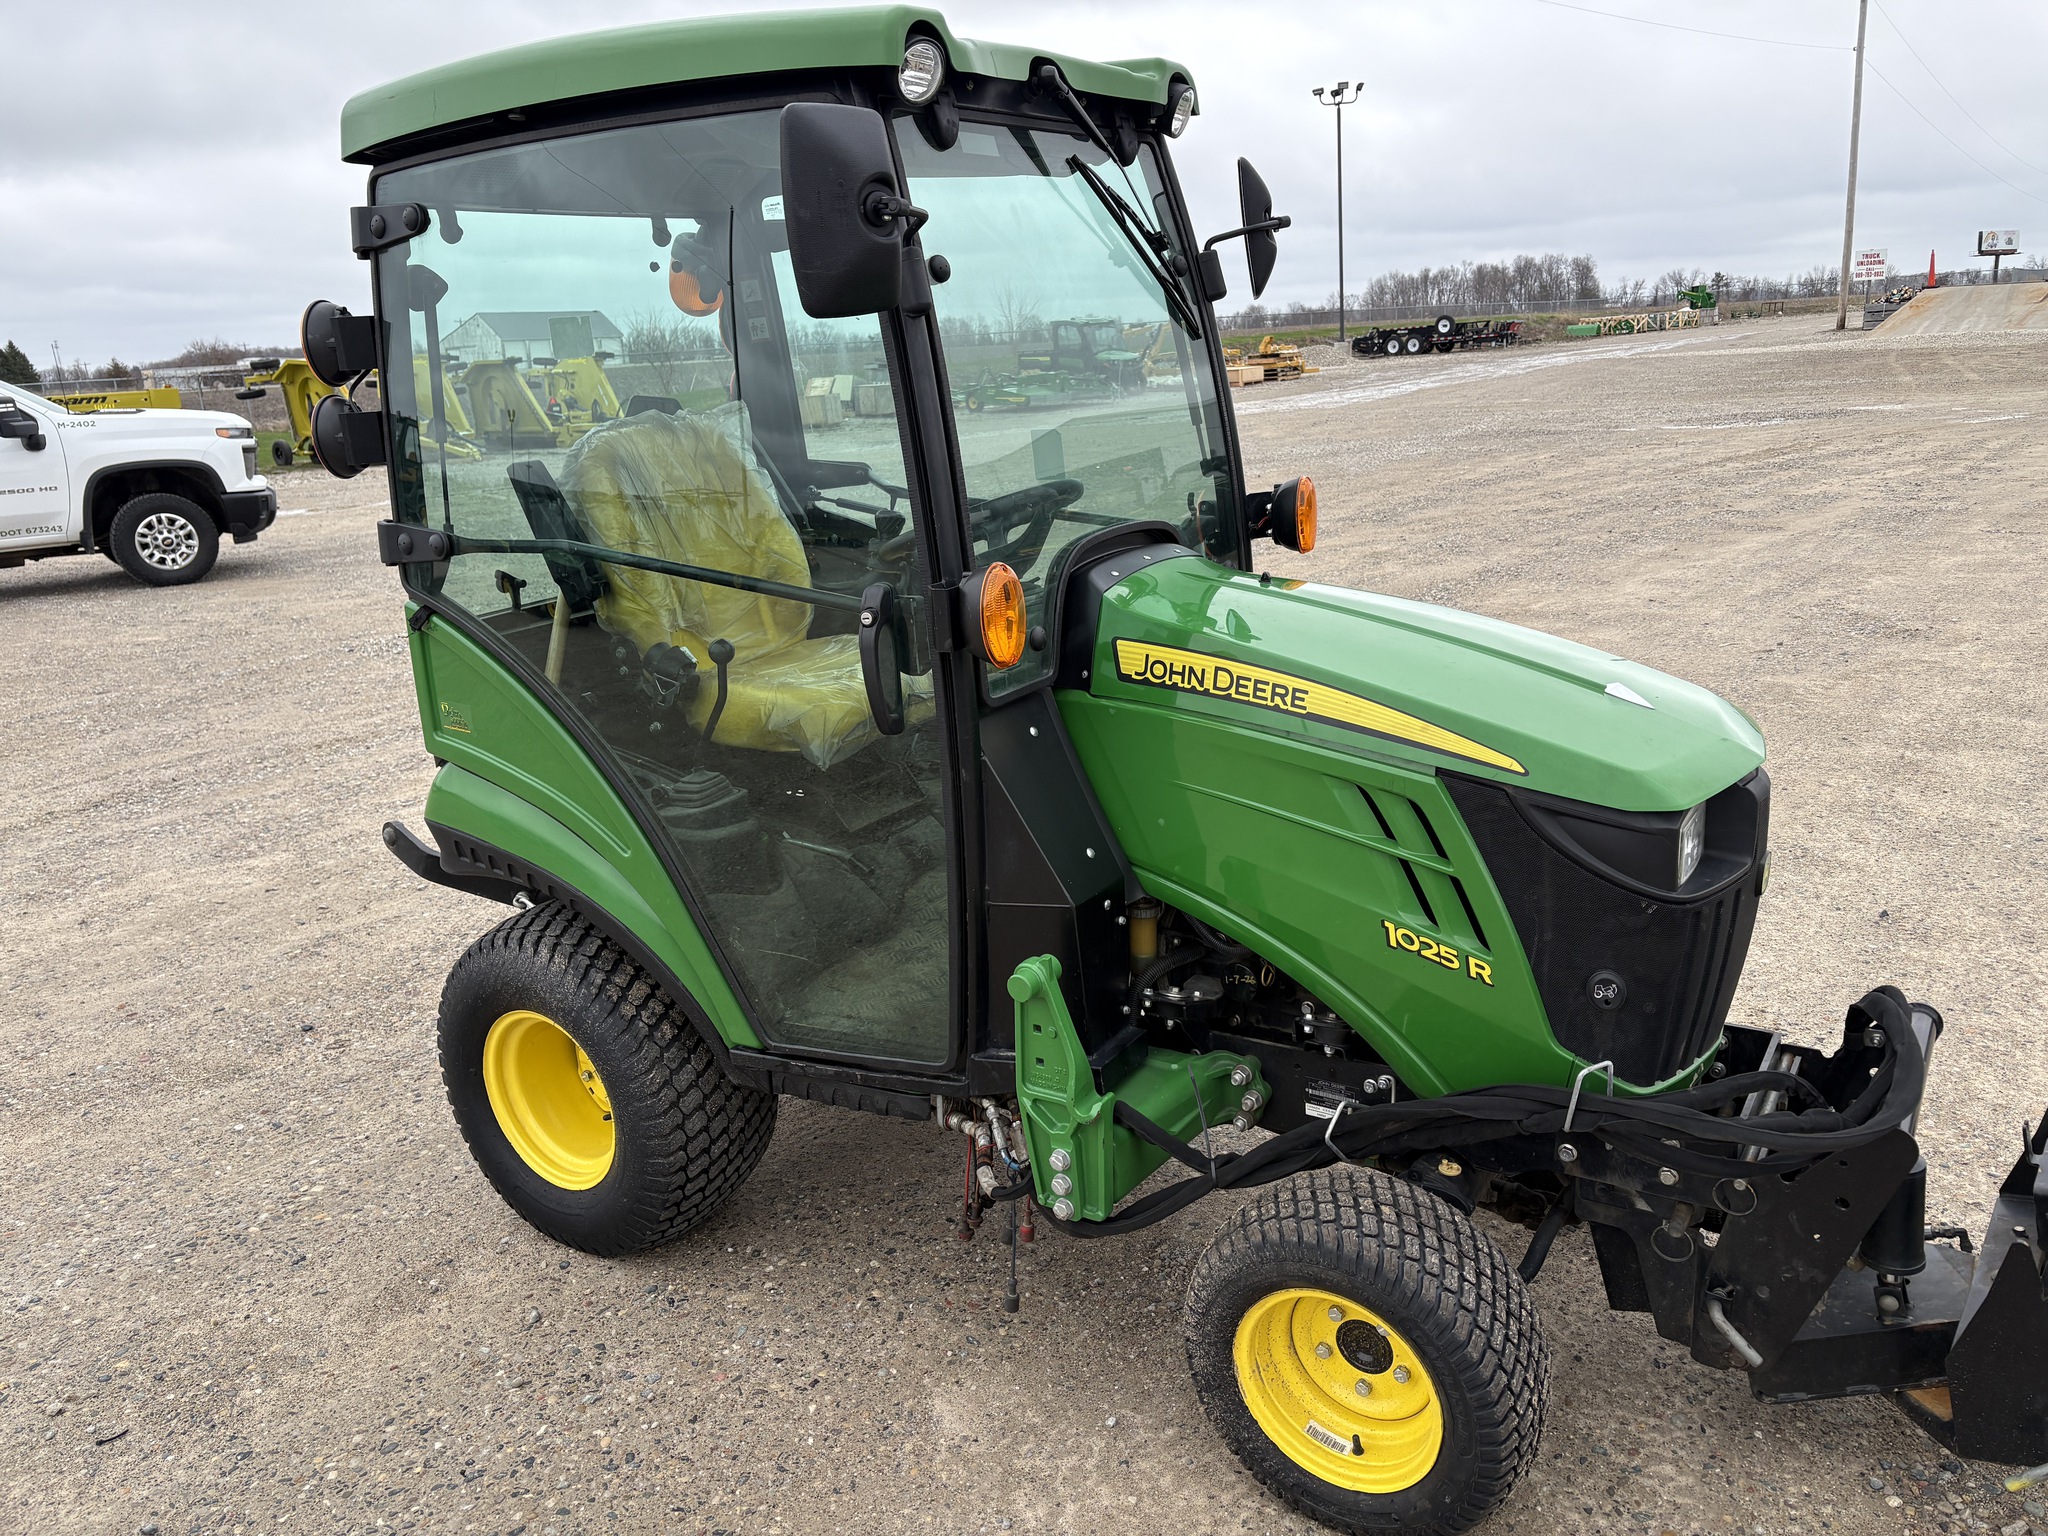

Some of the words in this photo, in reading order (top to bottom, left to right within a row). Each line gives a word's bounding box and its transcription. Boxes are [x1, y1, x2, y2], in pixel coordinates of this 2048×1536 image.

[1856, 259, 1885, 267] UNLOADING
[49, 395, 108, 407] earm
[57, 420, 97, 429] M-2402
[25, 525, 63, 534] 673243
[1134, 653, 1206, 689] JOHN
[1213, 665, 1309, 711] DEERE
[1381, 919, 1462, 970] 1025
[1465, 954, 1495, 987] R
